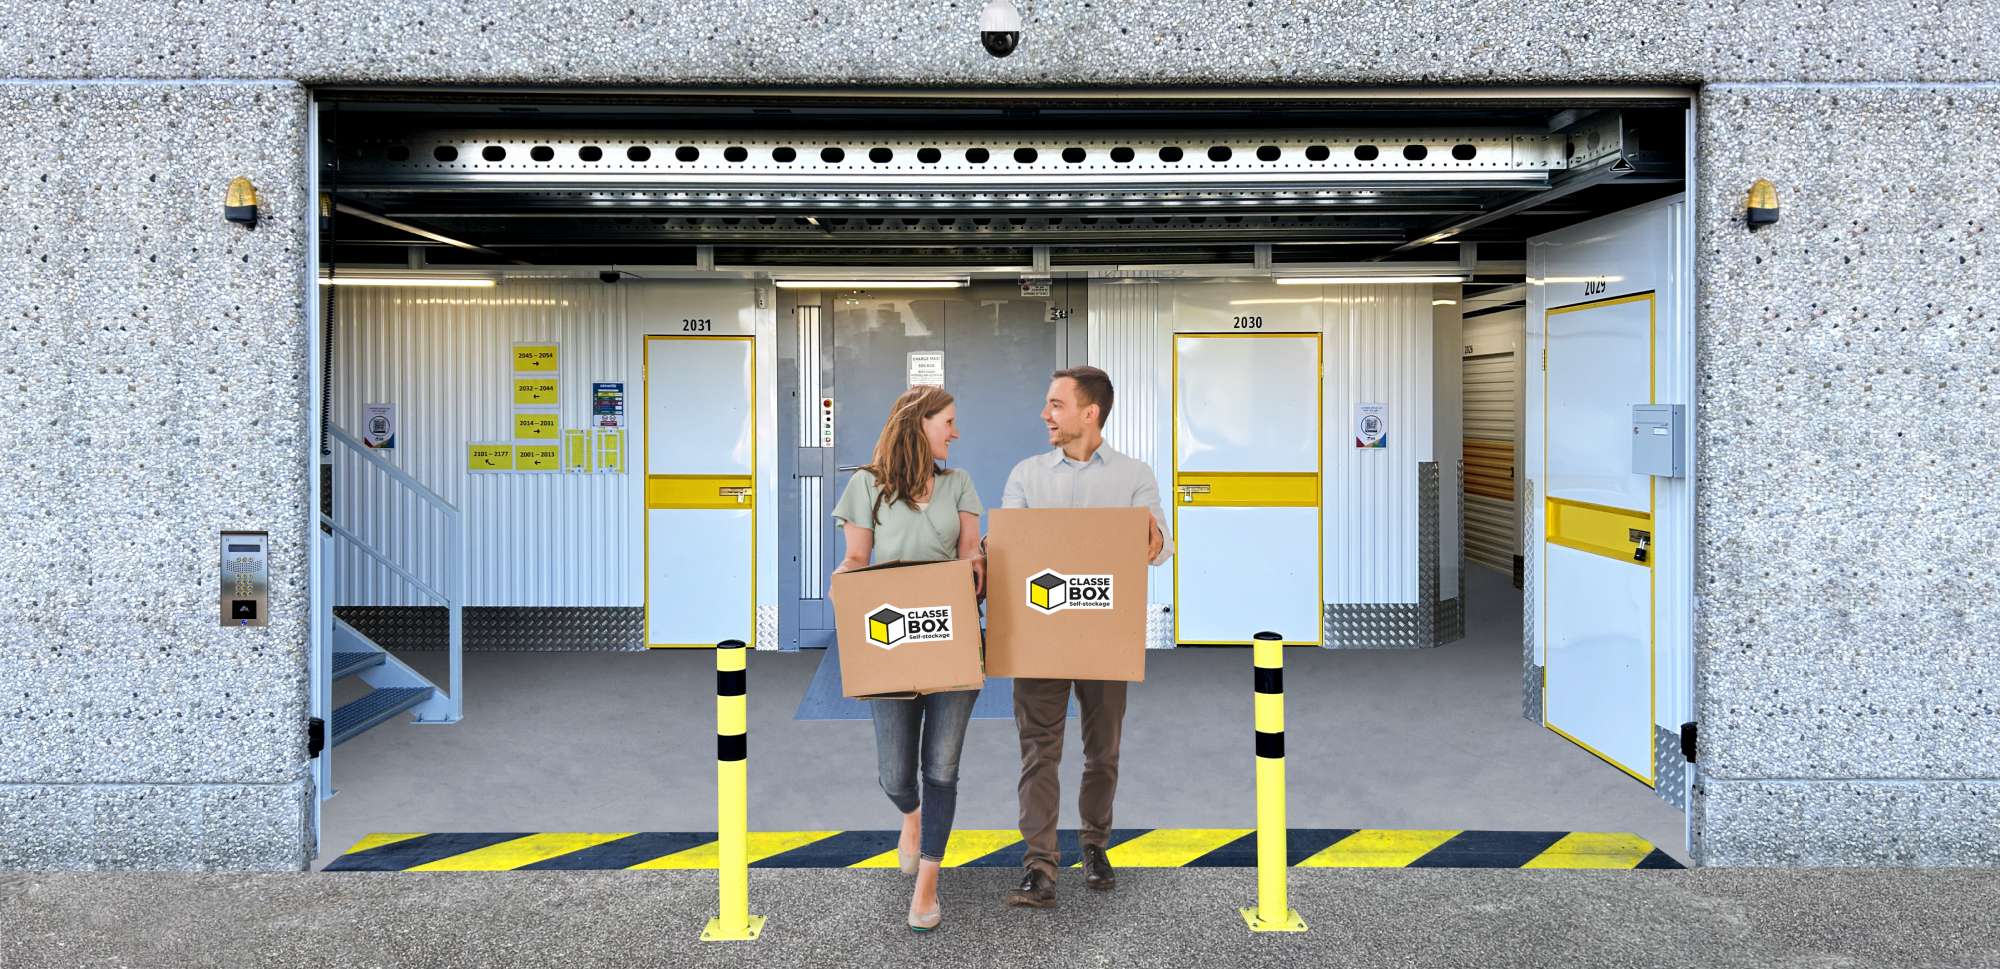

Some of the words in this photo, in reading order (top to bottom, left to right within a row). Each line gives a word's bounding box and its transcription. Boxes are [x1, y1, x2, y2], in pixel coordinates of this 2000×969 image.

[1584, 275, 1606, 296] 2029
[682, 319, 711, 331] 2031
[1233, 316, 1263, 329] 2030
[1069, 578, 1110, 586] CLASSE
[1069, 586, 1110, 600] BOX
[908, 609, 949, 619] CLASSE
[908, 618, 950, 634] BOX
